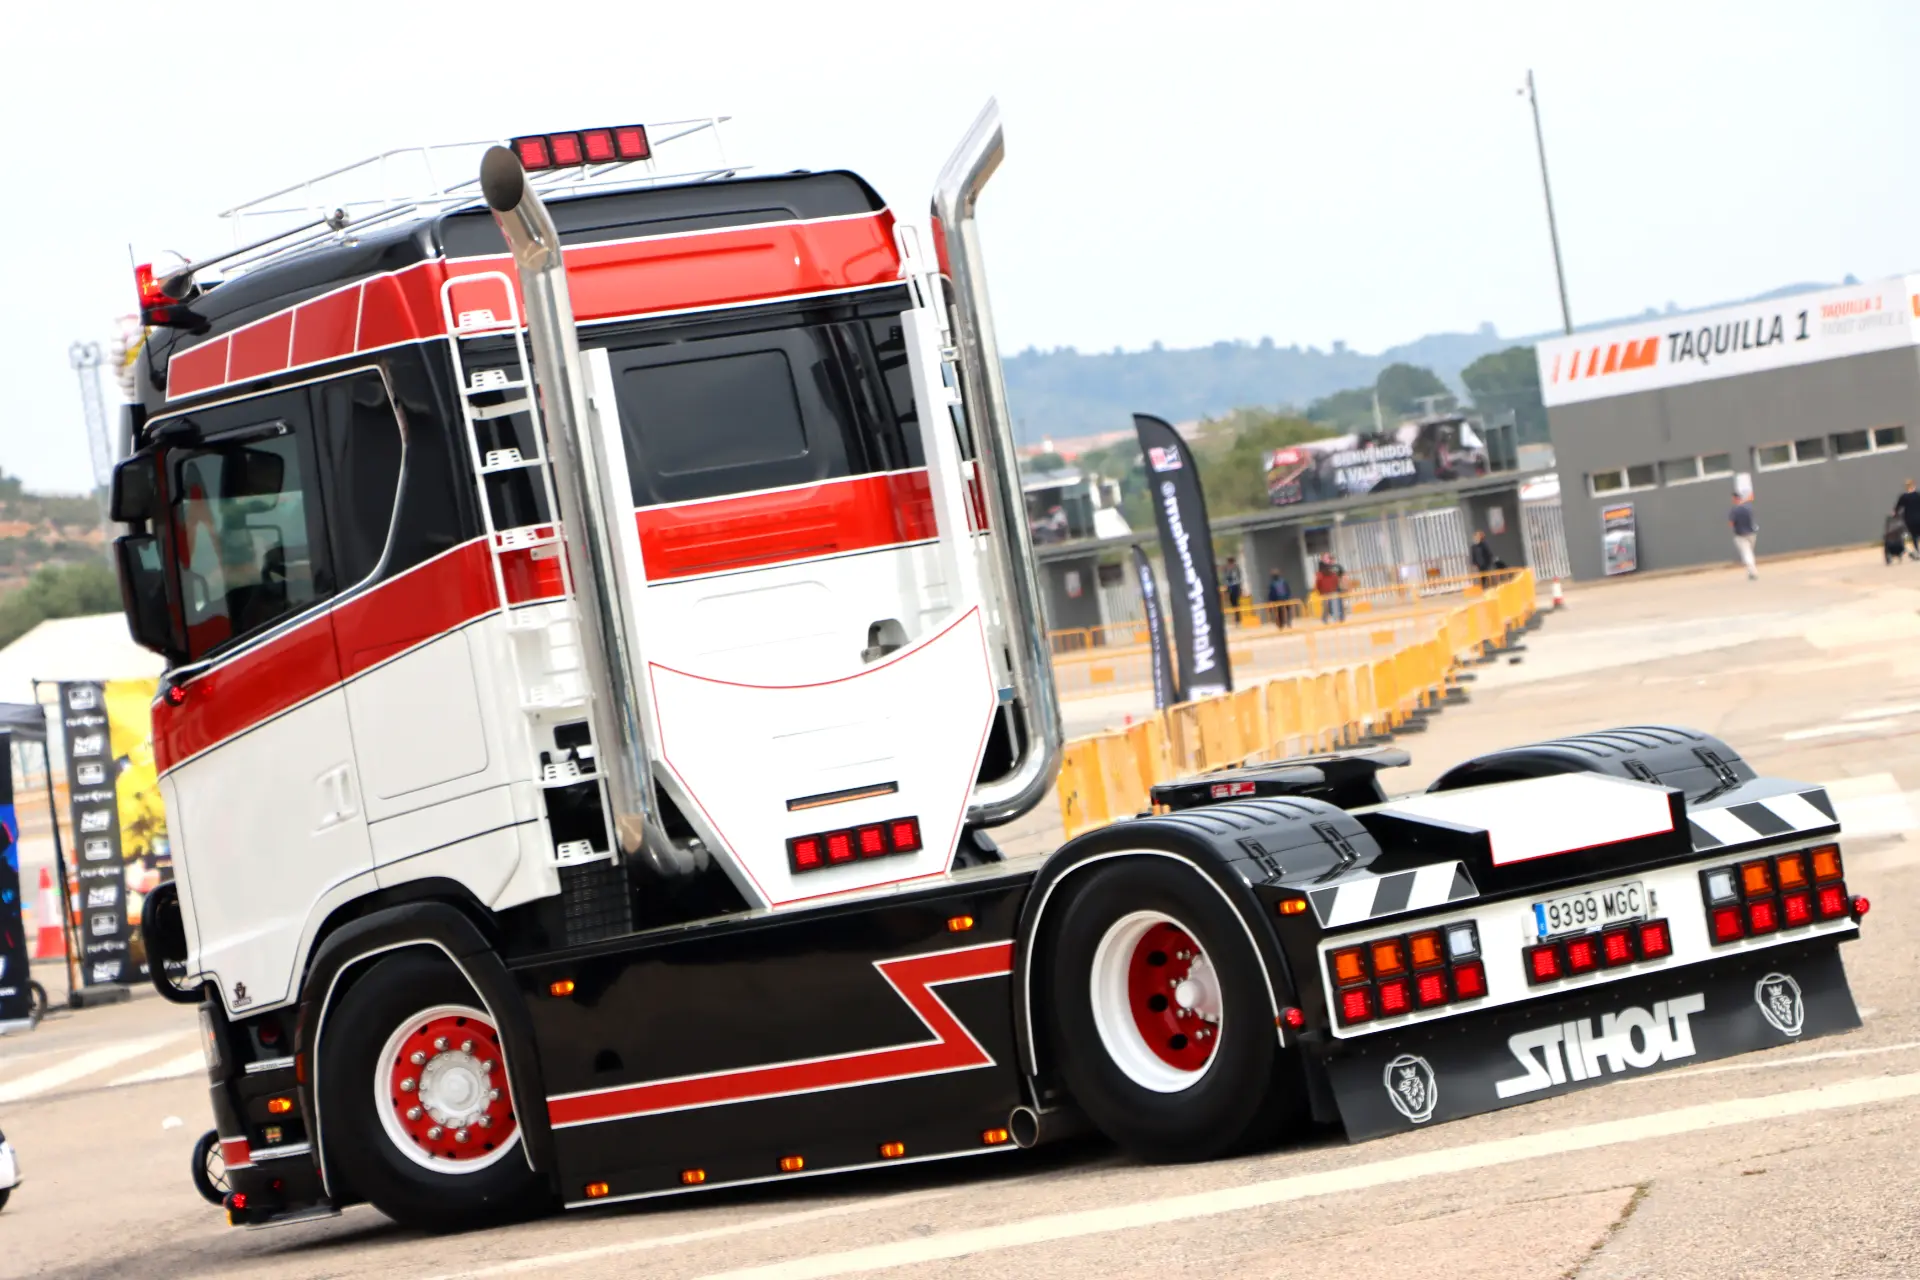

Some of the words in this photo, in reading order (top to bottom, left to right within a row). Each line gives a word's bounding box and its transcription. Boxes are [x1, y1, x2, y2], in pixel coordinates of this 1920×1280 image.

[1668, 313, 1785, 365] TAQUILLA
[1796, 310, 1810, 341] 1
[1349, 460, 1416, 482] VALENCIA
[1549, 898, 1598, 929] 9399
[1603, 888, 1640, 918] MGC
[1495, 992, 1705, 1099] STIHOLT
